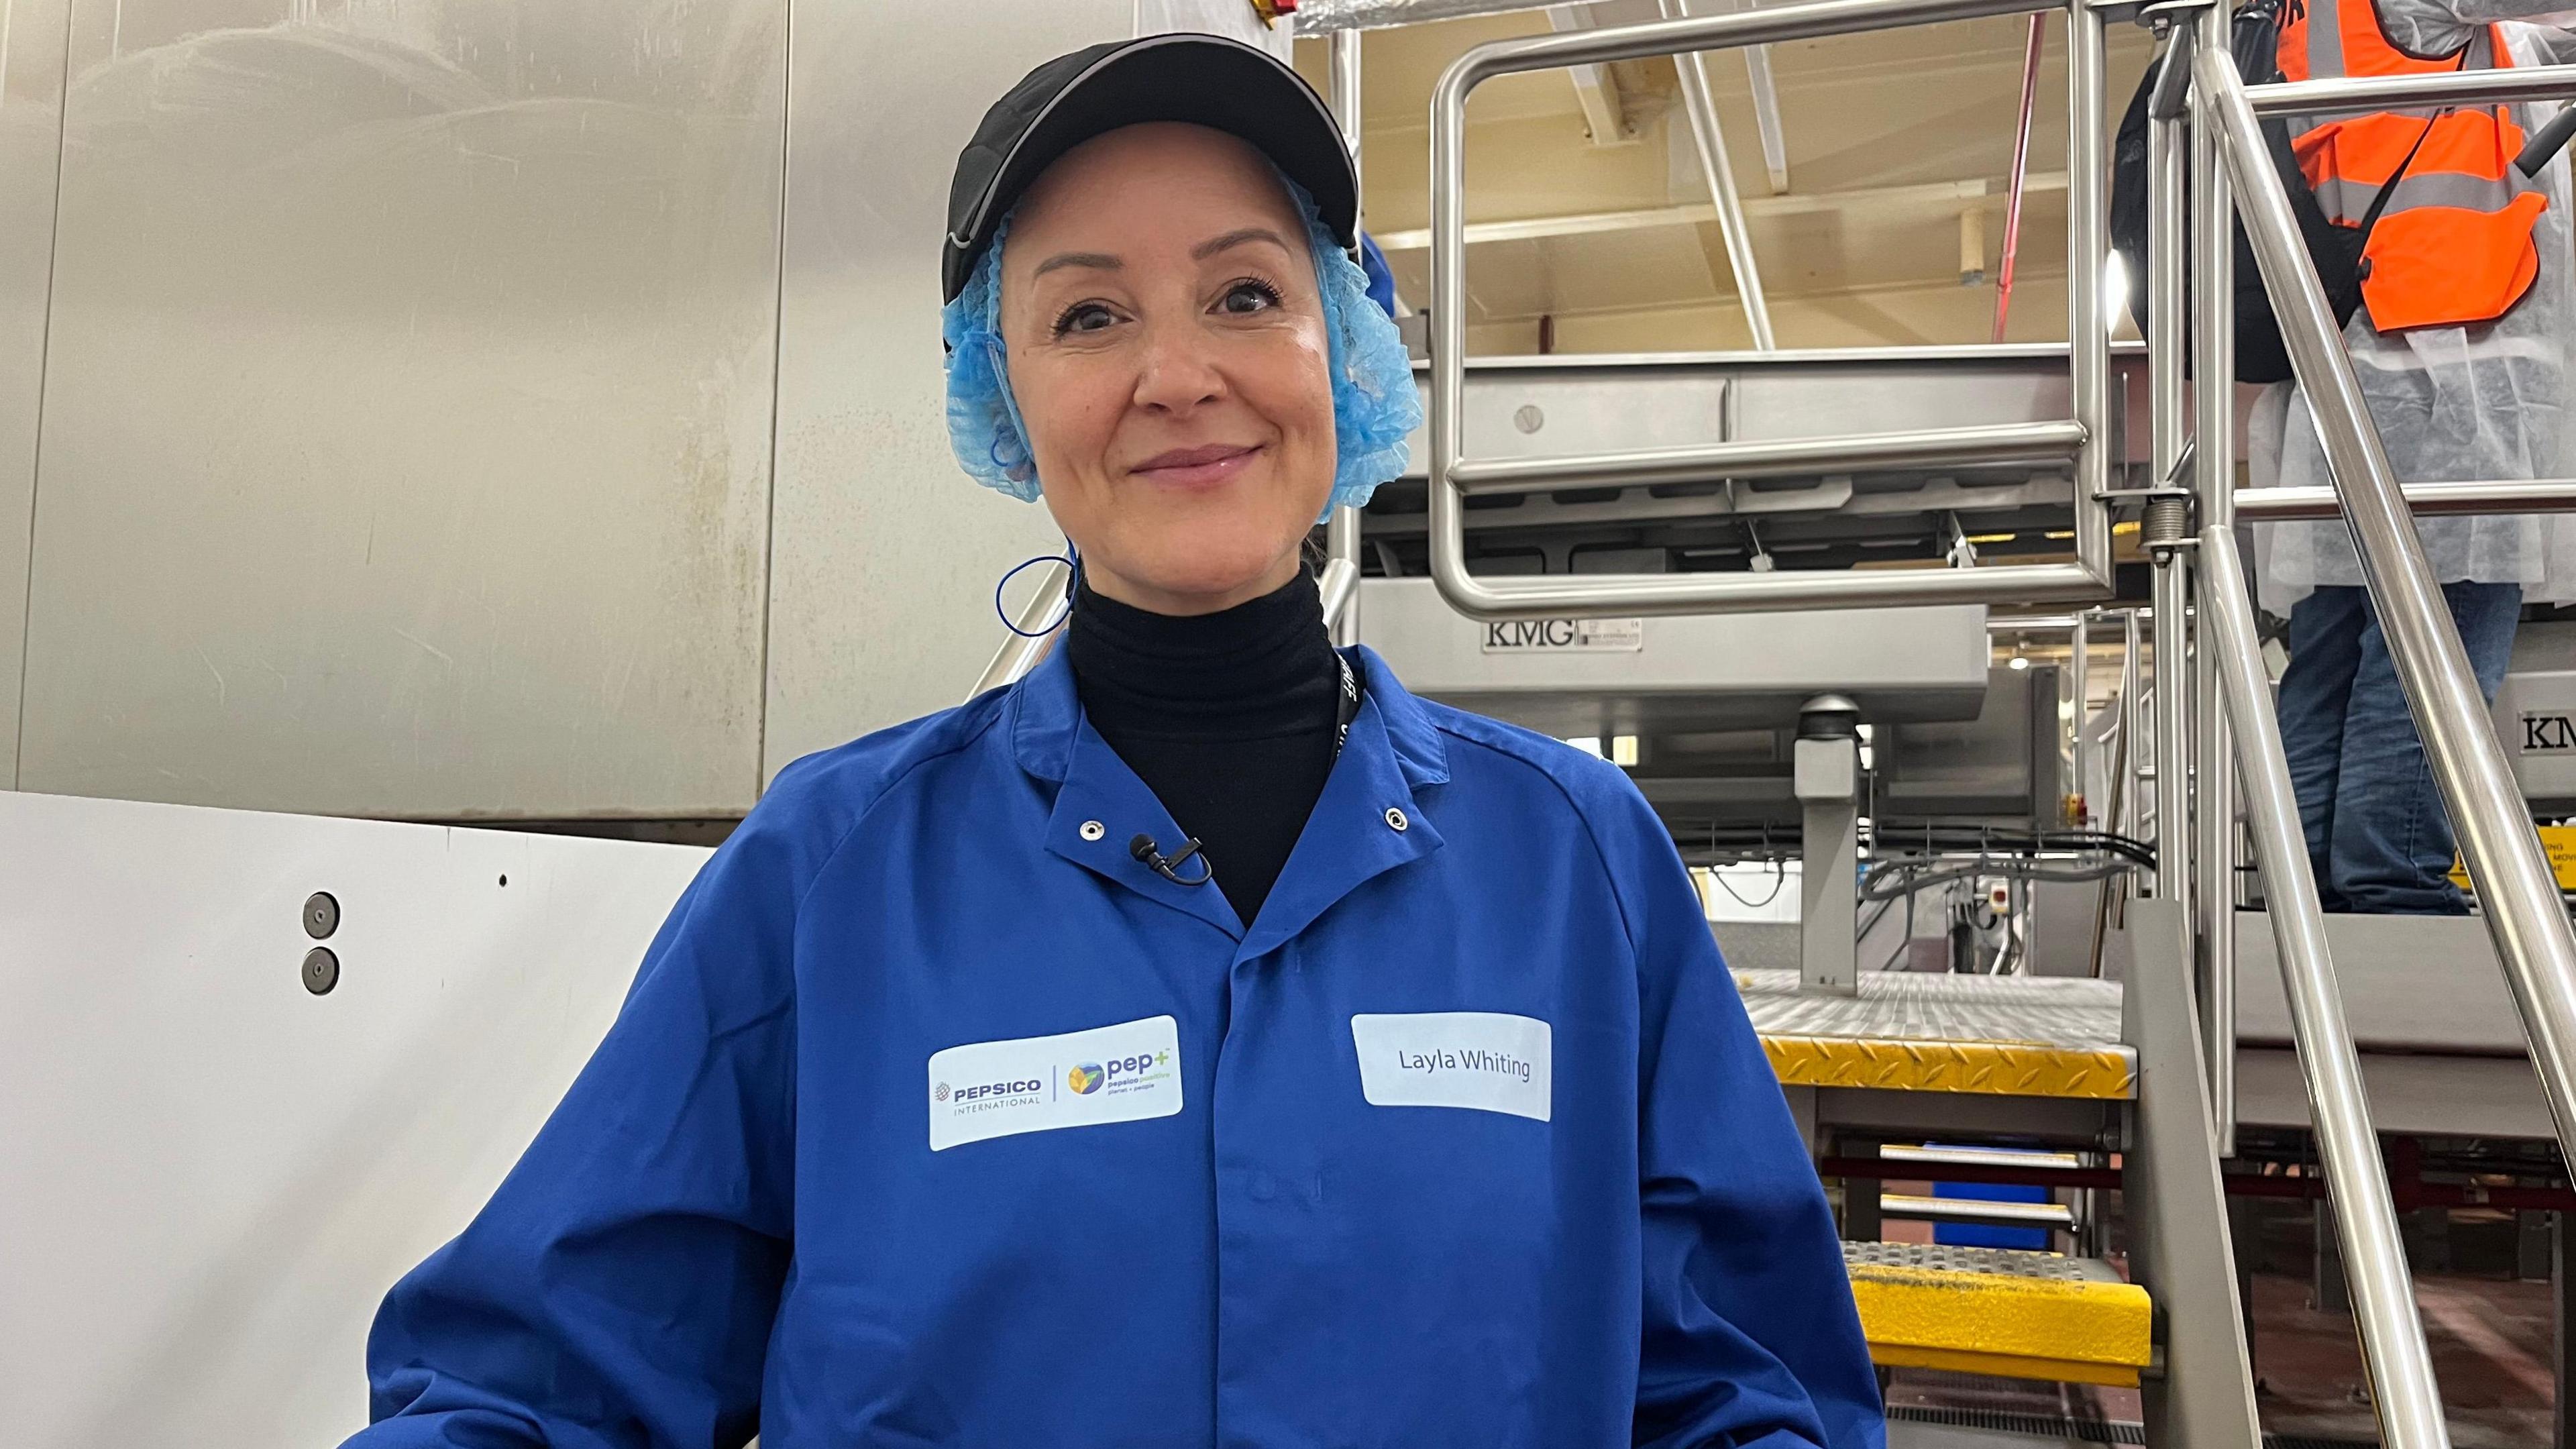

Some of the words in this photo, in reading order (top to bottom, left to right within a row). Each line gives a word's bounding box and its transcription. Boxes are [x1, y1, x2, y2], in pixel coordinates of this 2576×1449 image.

[1485, 621, 1573, 646] KMG
[1338, 655, 1356, 702] TAFF
[1399, 1049, 1456, 1073] Layla
[1460, 1050, 1529, 1083] Whiting
[955, 1080, 1041, 1102] PEPSICO
[1108, 1078, 1138, 1089] pepsico
[954, 1097, 1040, 1116] INTERNATIONAL
